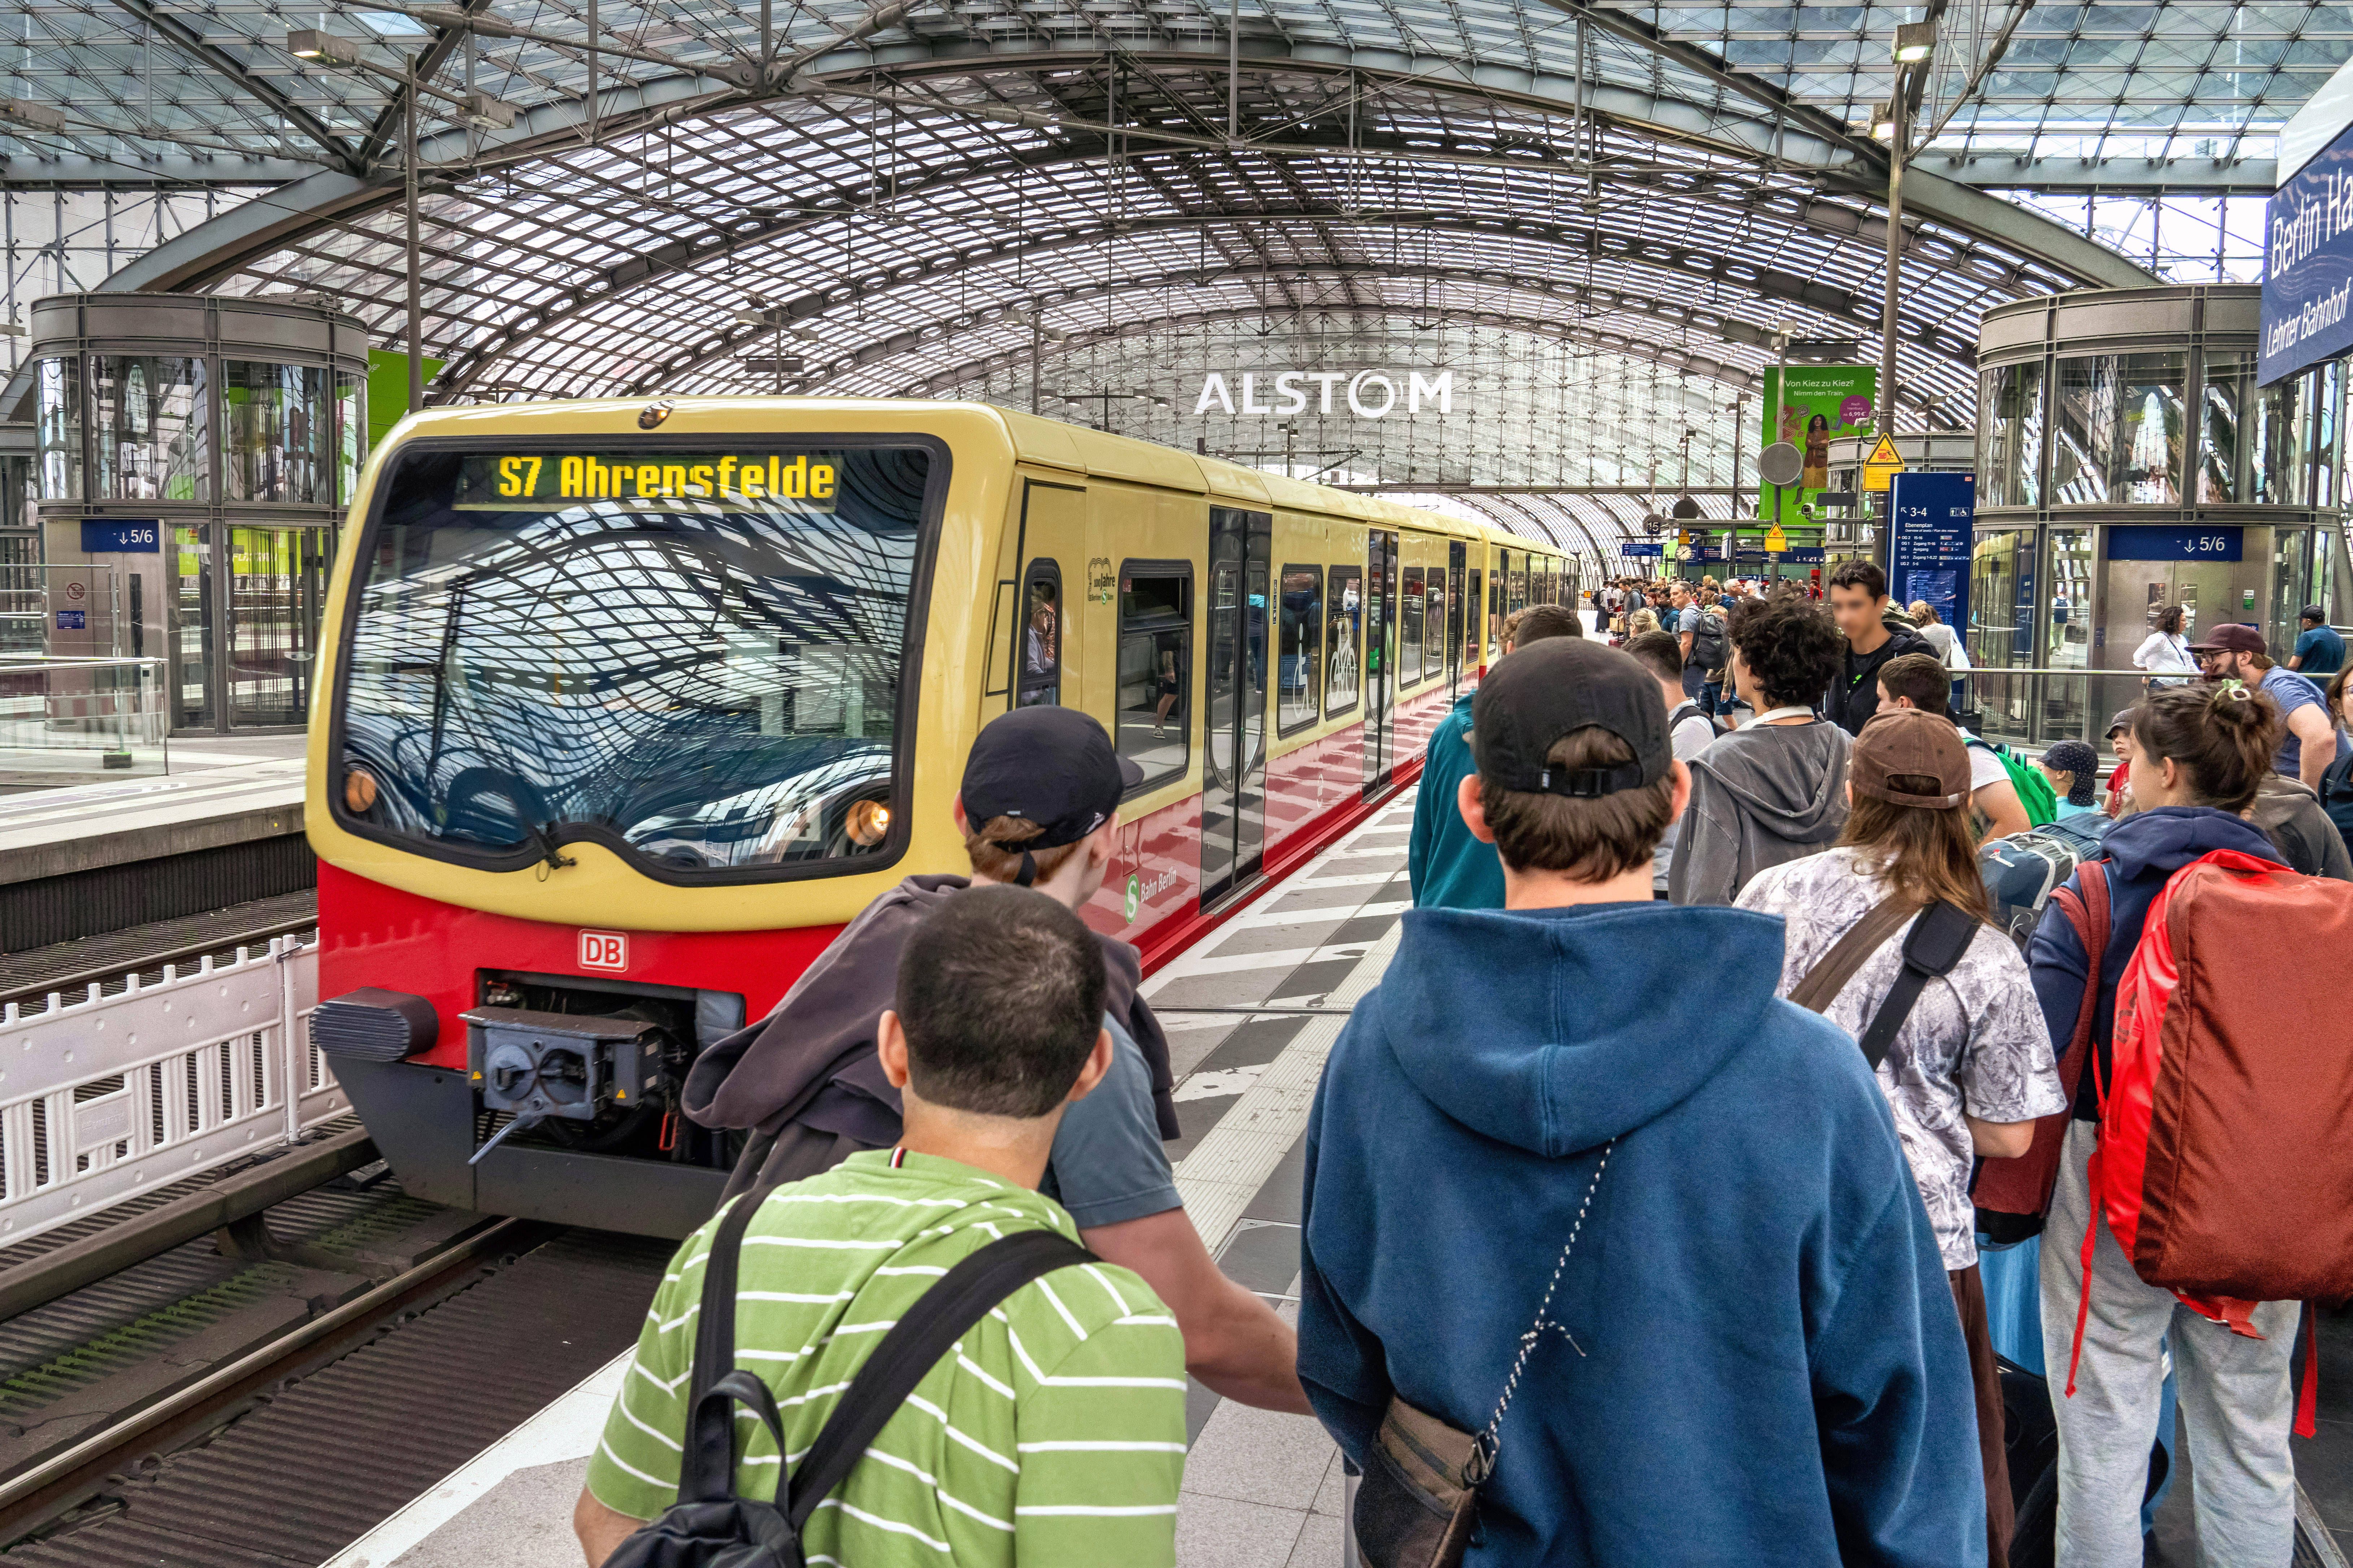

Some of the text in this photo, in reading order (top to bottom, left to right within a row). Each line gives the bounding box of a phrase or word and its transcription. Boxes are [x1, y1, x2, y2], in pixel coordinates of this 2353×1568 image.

[2271, 193, 2320, 280] Berlin
[2266, 276, 2352, 358] Lehrter Bahnhof
[1194, 369, 1453, 418] ALSTOM
[499, 456, 834, 498] S7 Ahrensfelde
[1647, 522, 1659, 531] 15
[1910, 508, 1927, 517] 3-4
[131, 530, 153, 543] 5/6
[2199, 537, 2225, 552] 5/6
[1100, 573, 1115, 591] Jahre
[1141, 878, 1157, 903] Bahn
[1158, 866, 1177, 893] Berlin
[586, 936, 621, 964] DB
